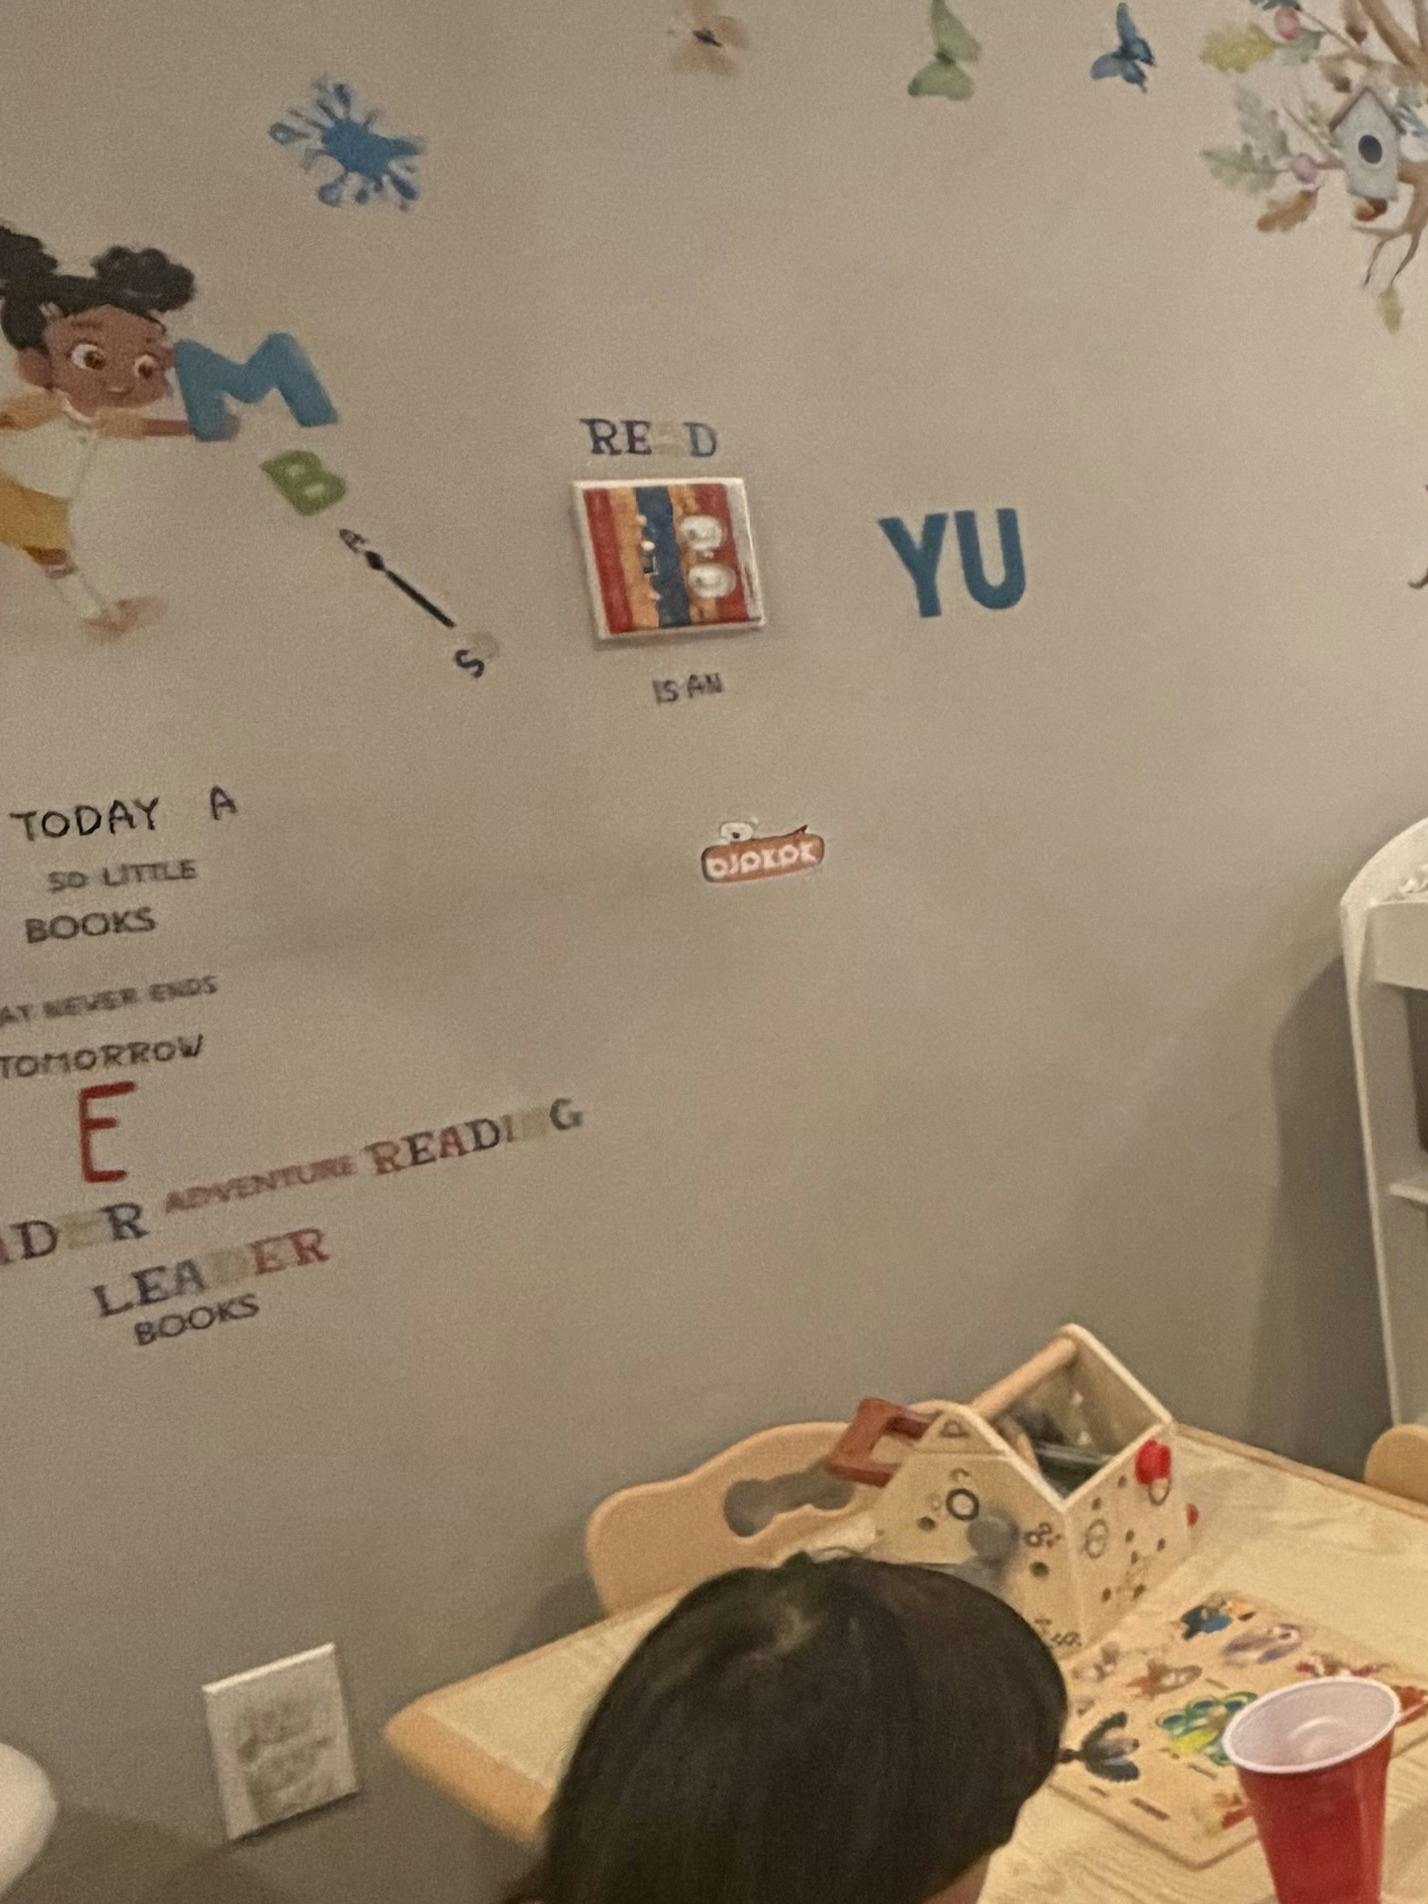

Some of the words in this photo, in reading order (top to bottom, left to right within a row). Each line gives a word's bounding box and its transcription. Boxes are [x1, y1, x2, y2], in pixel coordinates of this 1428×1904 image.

[173, 332, 338, 442] M
[580, 418, 718, 457] RED
[259, 450, 346, 516] B
[878, 507, 1026, 618] YU
[10, 797, 159, 841] TODAY
[209, 786, 239, 821] A
[48, 871, 88, 893] SO
[103, 859, 197, 886] LITTLE
[24, 907, 156, 943] BOOKS
[0, 1033, 204, 1080] TOMORROW
[78, 1081, 138, 1184] E
[164, 1154, 358, 1216] ADVENTURE
[364, 1097, 585, 1177] READIG
[92, 1227, 331, 1317] LEAER
[134, 1293, 260, 1346] BOOKS
